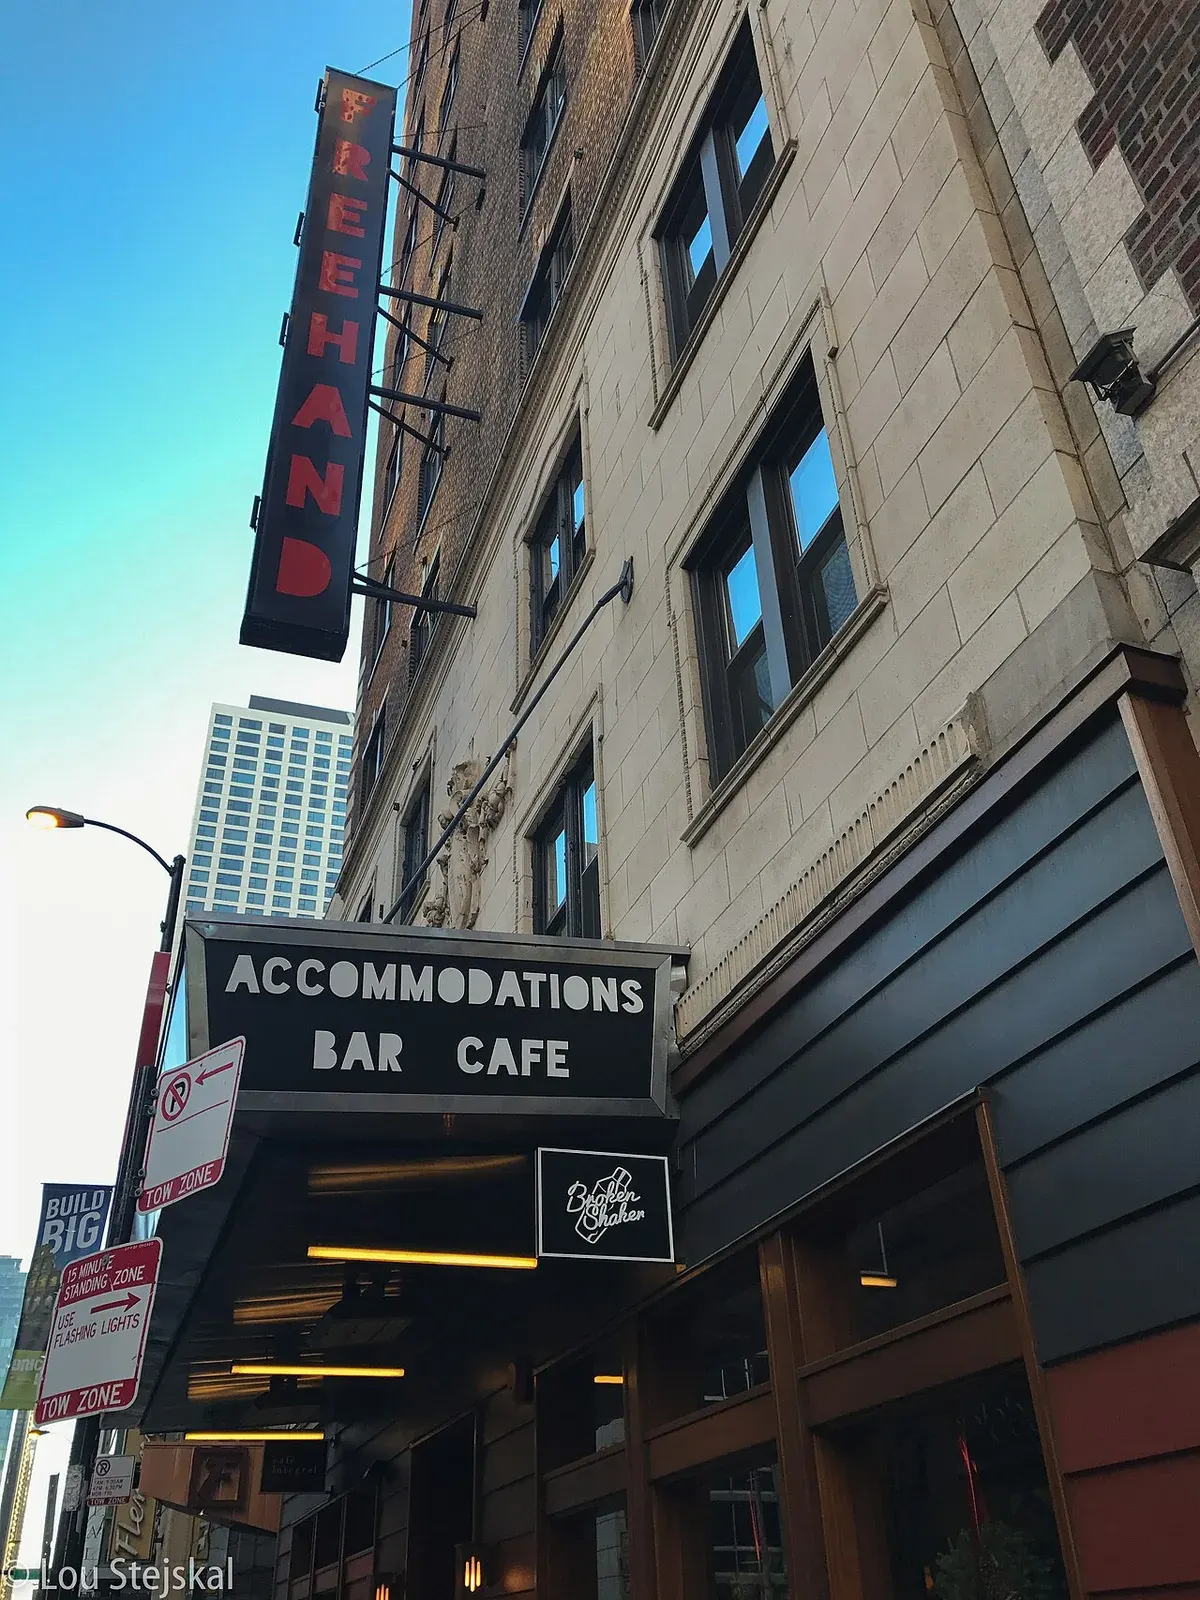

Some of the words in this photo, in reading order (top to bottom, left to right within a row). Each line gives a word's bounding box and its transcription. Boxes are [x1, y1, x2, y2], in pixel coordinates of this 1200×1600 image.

[275, 88, 377, 597] FREEHAND
[224, 954, 645, 1014] ACCOMMODATIONS
[313, 1030, 403, 1072] BAR
[457, 1036, 570, 1078] CAFE
[146, 1182, 173, 1208] TOW
[178, 1164, 214, 1195] ZONE
[566, 1180, 641, 1212] Broken
[46, 1190, 105, 1220] BUILD
[583, 1202, 645, 1230] Shaker
[41, 1212, 101, 1254] BIG
[63, 1274, 108, 1302] STANDING
[113, 1265, 145, 1286] ZONE
[67, 1268, 78, 1284] 15
[53, 1322, 97, 1349] FLASHING
[101, 1313, 140, 1335] LIGHTS
[57, 1311, 76, 1331] USE
[42, 1394, 71, 1421] TOW
[77, 1383, 124, 1412] ZONE
[107, 1496, 126, 1504] ZONE
